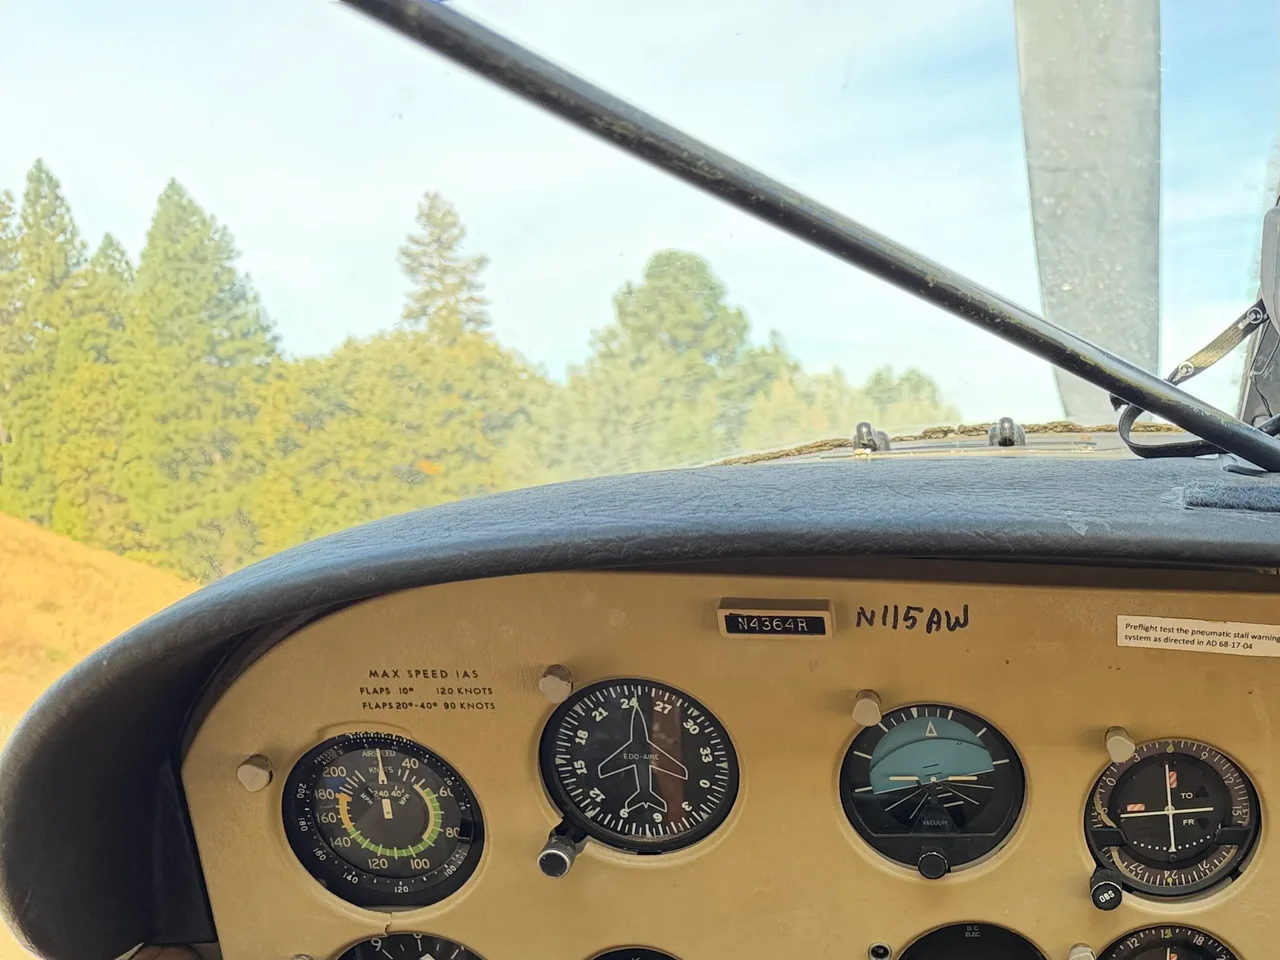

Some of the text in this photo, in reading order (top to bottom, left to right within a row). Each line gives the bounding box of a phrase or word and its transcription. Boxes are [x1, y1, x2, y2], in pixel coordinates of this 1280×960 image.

[737, 617, 808, 631] N4364R
[856, 604, 969, 633] N115AW
[1125, 623, 1157, 632] Preflight
[1191, 629, 1231, 638] pneumatic
[1251, 634, 1280, 643] warning
[1124, 634, 1151, 642] system
[1163, 637, 1195, 645] directed
[1219, 641, 1252, 650] 68-17-04
[369, 670, 478, 678] MAX SPEED IAS
[360, 687, 391, 695] FLAPS
[654, 702, 672, 715] 27
[700, 747, 713, 763] 33
[323, 766, 346, 777] 200
[315, 789, 334, 799] 180
[317, 812, 337, 823] 160
[331, 837, 351, 848] 140
[368, 858, 388, 870] 120
[410, 858, 430, 870] 100
[1129, 862, 1145, 873] 27
[1099, 890, 1115, 903] OBS
